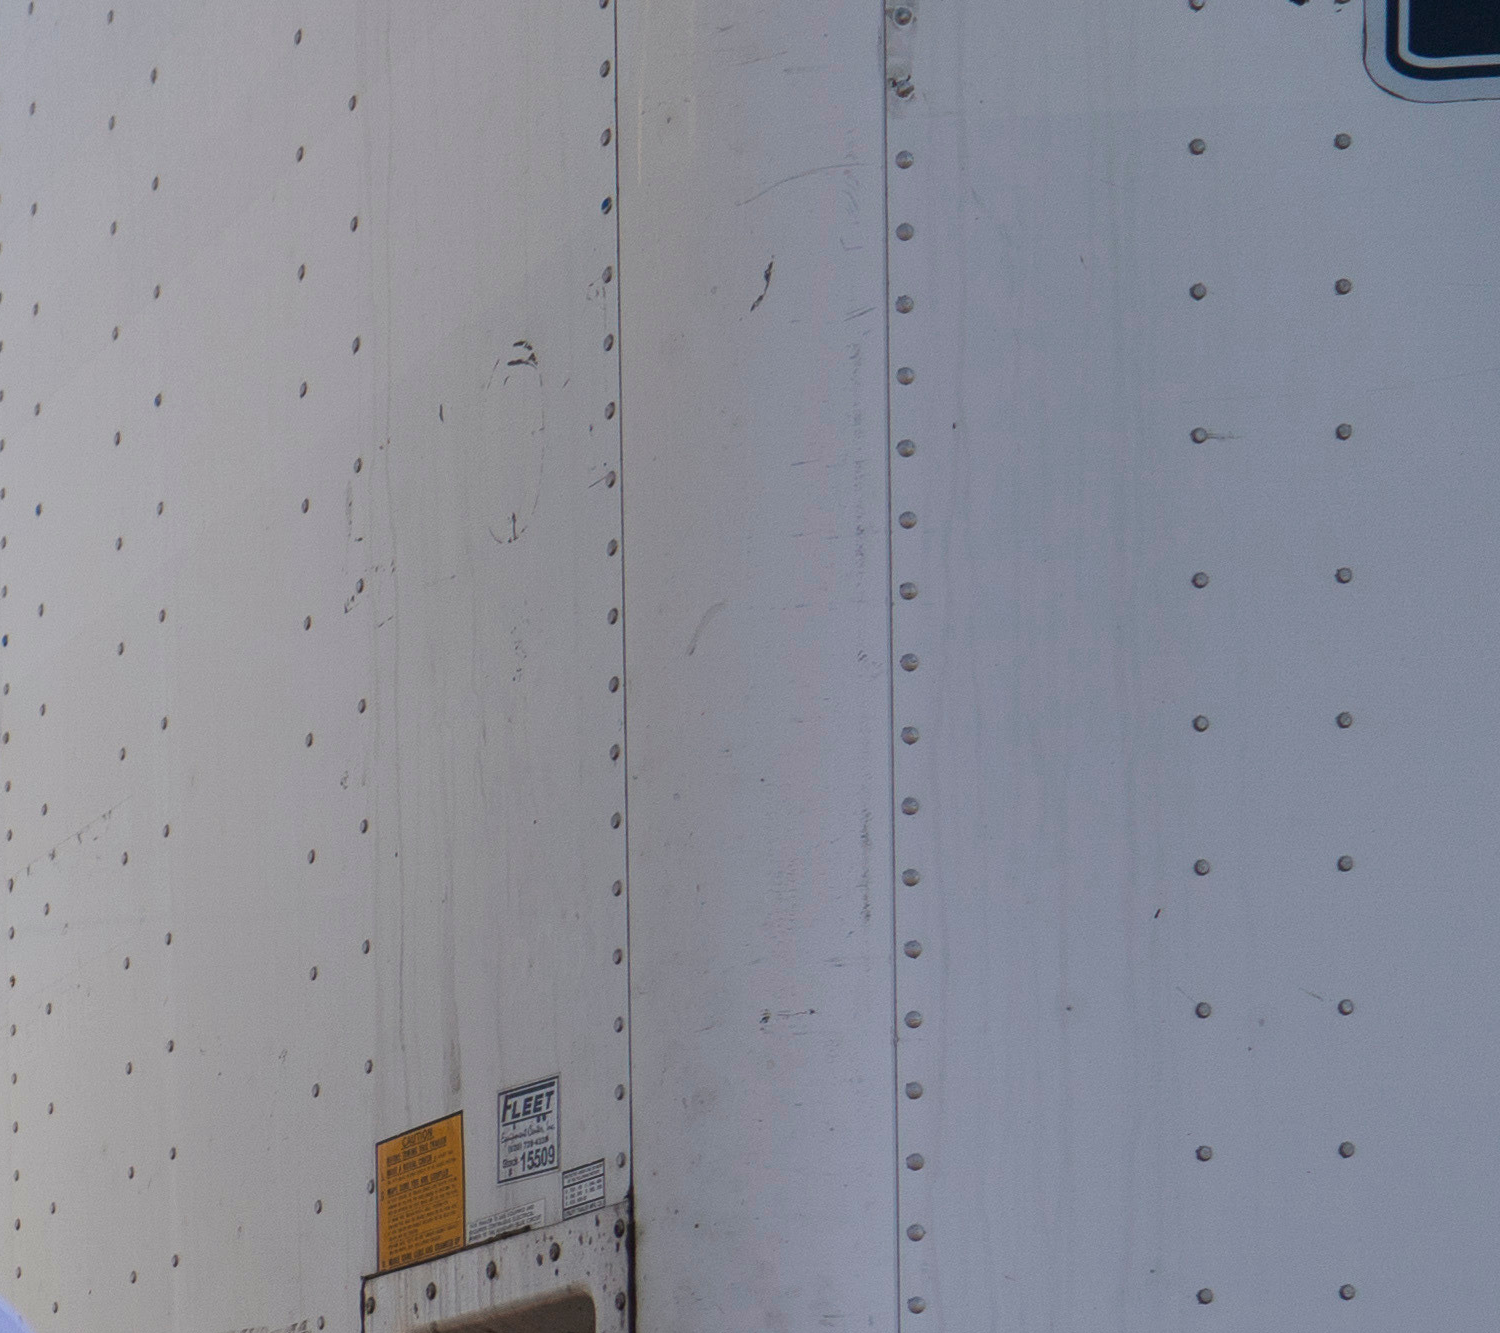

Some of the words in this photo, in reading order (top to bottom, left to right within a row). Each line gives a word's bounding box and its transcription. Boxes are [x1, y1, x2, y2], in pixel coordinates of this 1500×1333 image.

[501, 1081, 555, 1122] FLEET
[402, 1128, 433, 1149] CAUTION
[521, 1145, 555, 1172] 15509
